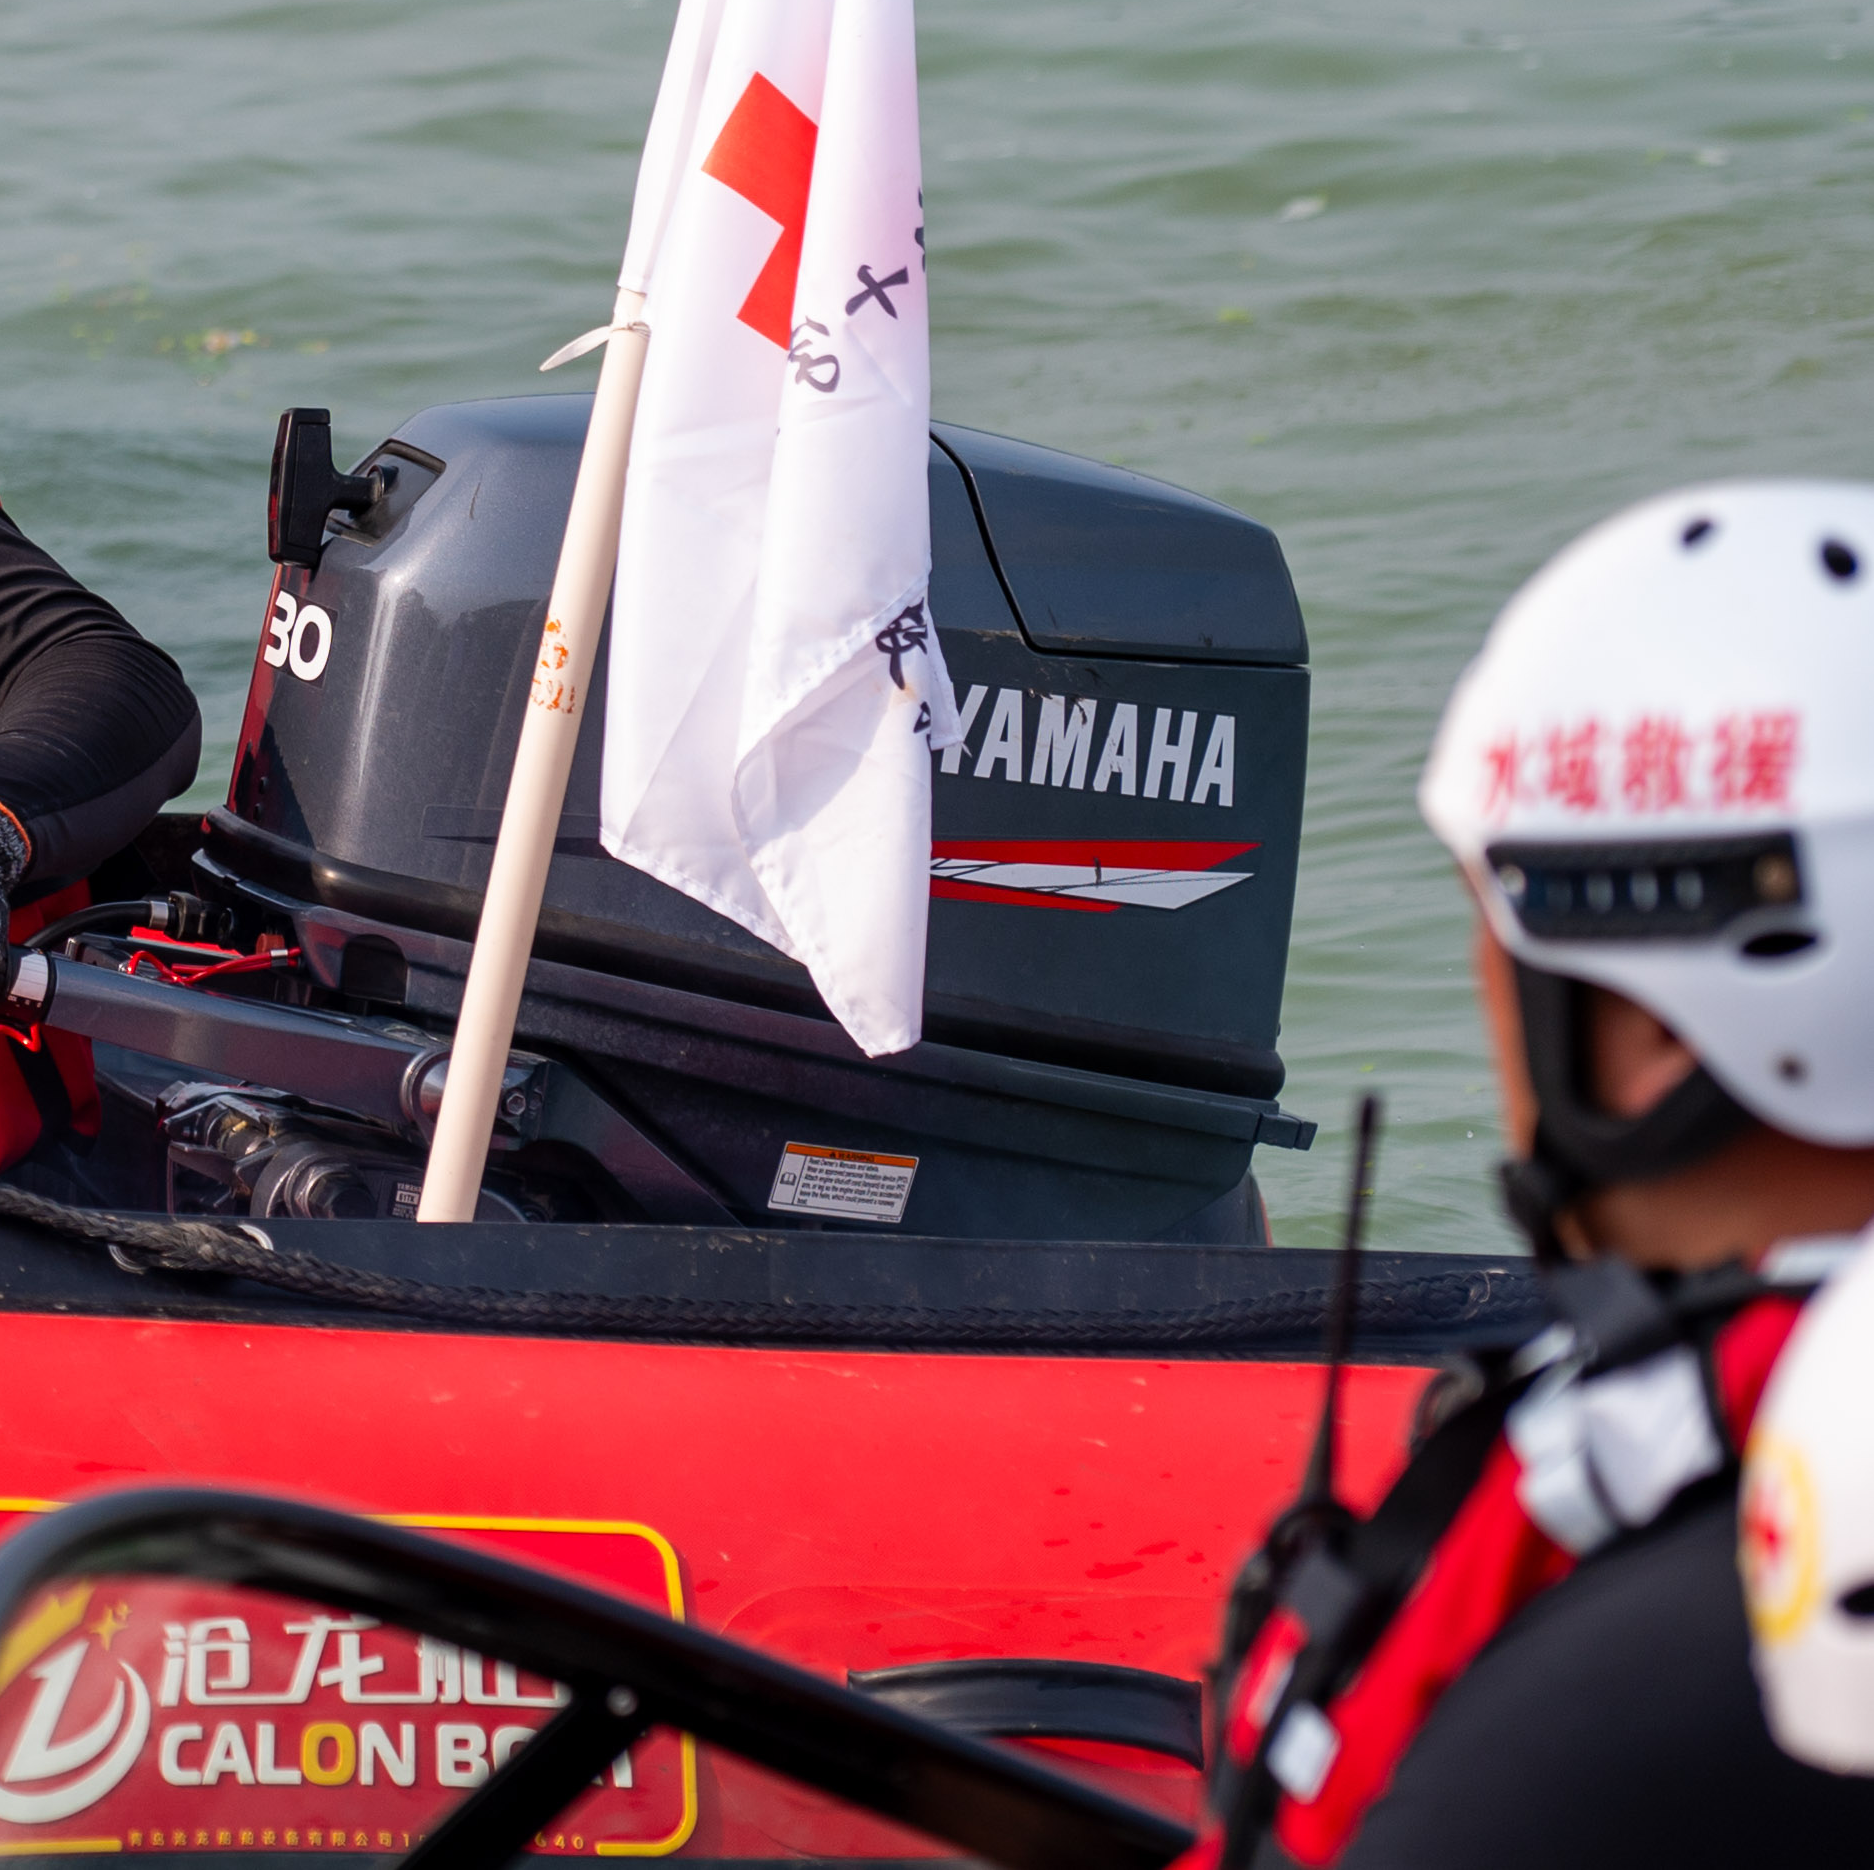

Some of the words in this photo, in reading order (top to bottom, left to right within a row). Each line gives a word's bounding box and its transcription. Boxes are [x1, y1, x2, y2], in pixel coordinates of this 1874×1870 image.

[263, 590, 333, 681] 30
[940, 683, 1236, 808] YAMAHA
[1481, 710, 1801, 818] 水域救援
[158, 1720, 417, 1787] CALON
